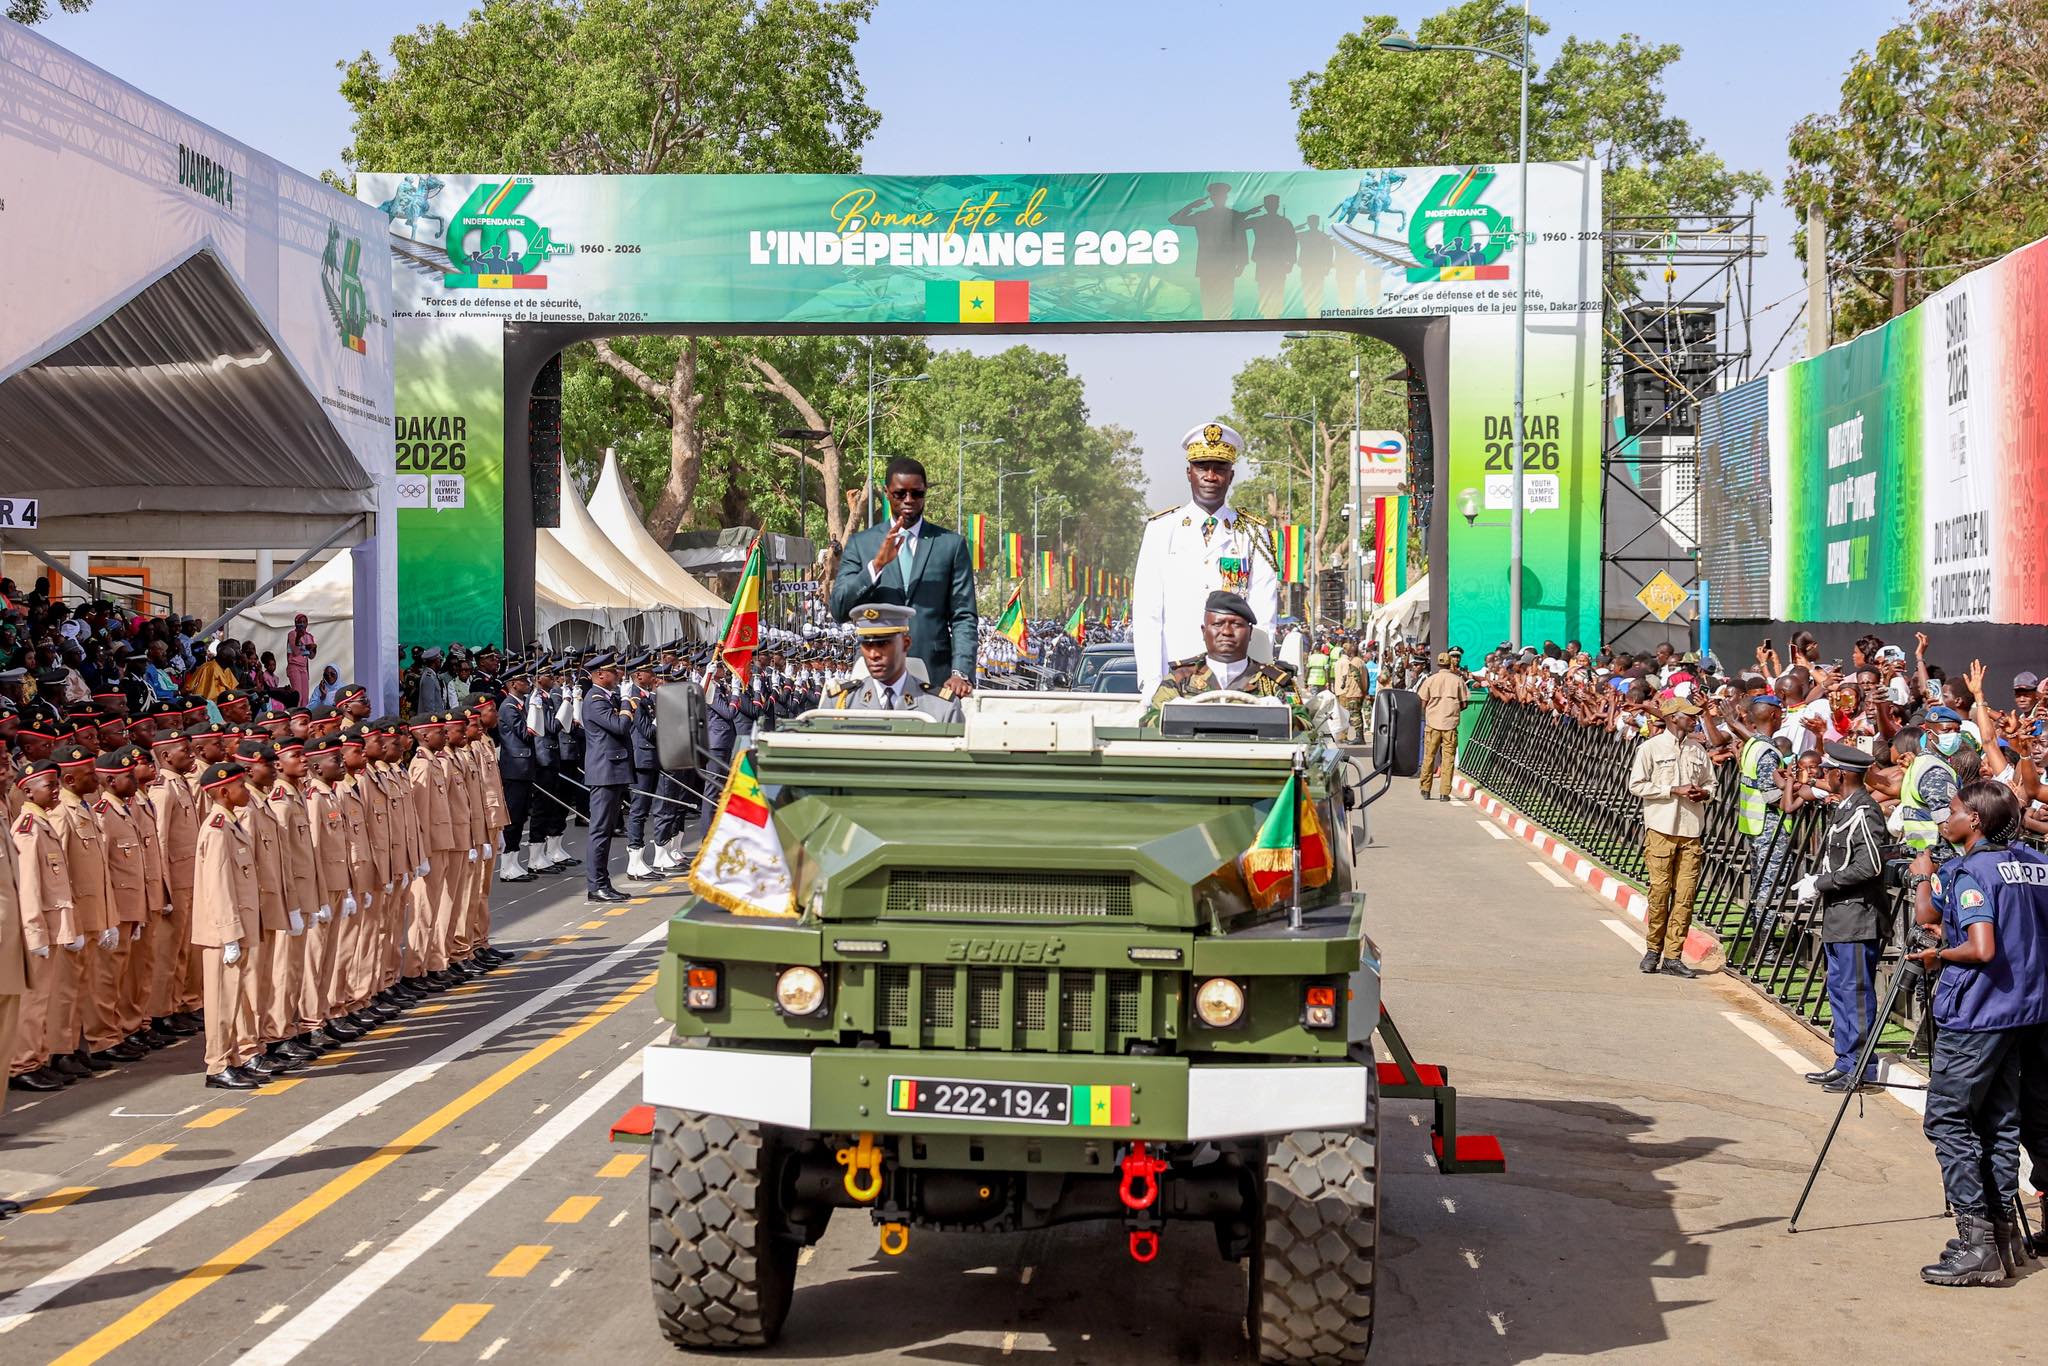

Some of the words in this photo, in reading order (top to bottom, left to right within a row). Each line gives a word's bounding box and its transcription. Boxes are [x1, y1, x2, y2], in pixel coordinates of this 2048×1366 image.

[179, 143, 225, 206] DIAMBAR
[226, 171, 233, 210] 4
[516, 176, 534, 184] ans
[824, 187, 938, 244] Bonne
[1015, 187, 1049, 228] de
[1425, 208, 1488, 218] INDEPENDANCE
[463, 217, 526, 226] INDEPENDANCE
[1543, 232, 1567, 241] 1960
[528, 226, 551, 262] 4
[545, 242, 572, 255] Avril
[580, 244, 604, 254] 1960
[615, 244, 641, 254] 2026
[1073, 229, 1180, 266] 2026
[1422, 291, 1434, 300] de
[1436, 290, 1473, 300] défense
[1475, 290, 1485, 299] et
[1487, 289, 1499, 299] de
[1502, 288, 1544, 300] sécrité,
[421, 297, 458, 307] "Forces
[460, 297, 472, 307] de
[474, 297, 511, 307] défense
[513, 298, 523, 307] et
[526, 298, 538, 307] de
[540, 298, 582, 310] sécurité,
[1320, 306, 1374, 319] partenaires
[1421, 304, 1475, 315] olympiques
[1477, 303, 1489, 312] de
[1491, 302, 1500, 312] la
[1501, 301, 1547, 314] jeuesse,
[1550, 301, 1578, 311] Dakar
[515, 311, 527, 321] de
[529, 311, 538, 321] la
[540, 311, 585, 323] jeunesse,
[588, 312, 616, 321] Dakar
[1947, 343, 1969, 406] 2026
[395, 416, 466, 441] DAKAR
[395, 442, 466, 471] 2026
[438, 479, 457, 487] YOUTH
[1531, 479, 1551, 487] YOUTH
[434, 487, 460, 495] OLYMPIC
[1527, 487, 1554, 496] OLYMPIC
[437, 495, 458, 503] GAMES
[1530, 495, 1552, 503] GAMES
[22, 500, 37, 527] 4
[773, 582, 809, 593] CAYOR
[812, 582, 818, 590] 1
[945, 936, 1066, 964] acmat
